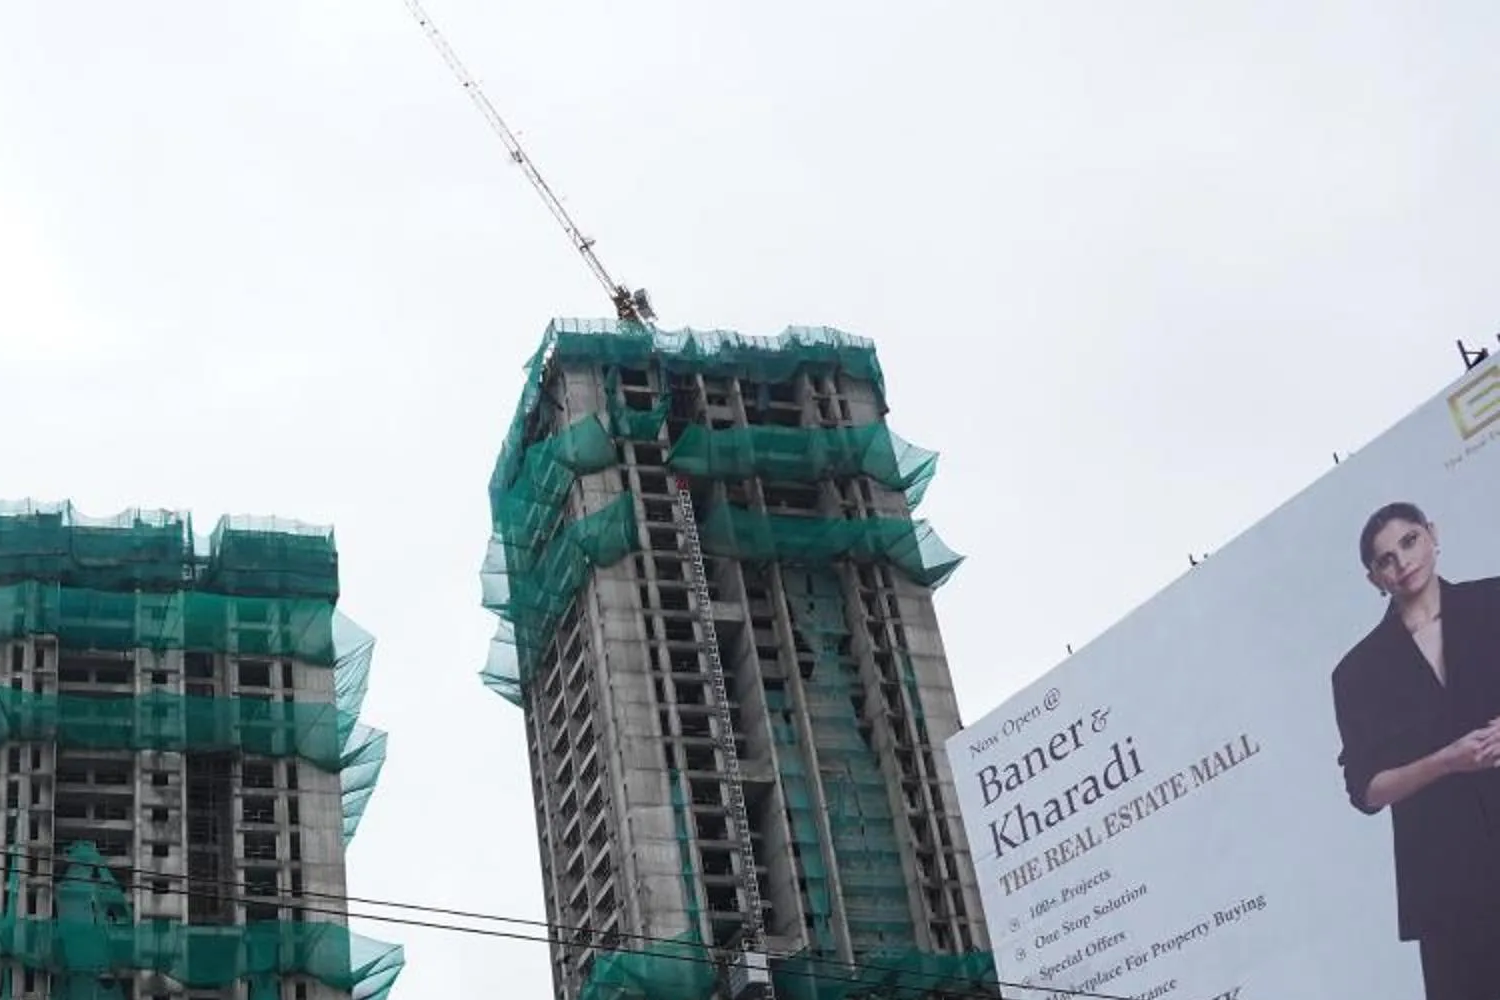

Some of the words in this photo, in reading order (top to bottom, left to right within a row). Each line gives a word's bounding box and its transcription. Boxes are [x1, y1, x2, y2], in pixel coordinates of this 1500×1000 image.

[969, 732, 999, 759] Now
[1002, 706, 1041, 736] Open
[1043, 687, 1061, 711] @
[976, 718, 1084, 808] Baner
[1091, 706, 1111, 733] &
[987, 736, 1145, 859] Kharadi
[999, 857, 1043, 896] THE
[1043, 826, 1102, 873] REAL
[1103, 772, 1188, 839] ESTATE
[1190, 733, 1261, 788] MALL
[1035, 929, 1060, 949] One
[1062, 914, 1091, 934] Stop
[1093, 883, 1148, 916] Solution
[1061, 869, 1112, 902] Projects
[1039, 949, 1083, 981] Special
[1085, 931, 1126, 957] Offers
[1125, 952, 1150, 971] For
[1151, 920, 1210, 958] Property
[1213, 895, 1267, 927] Buying
